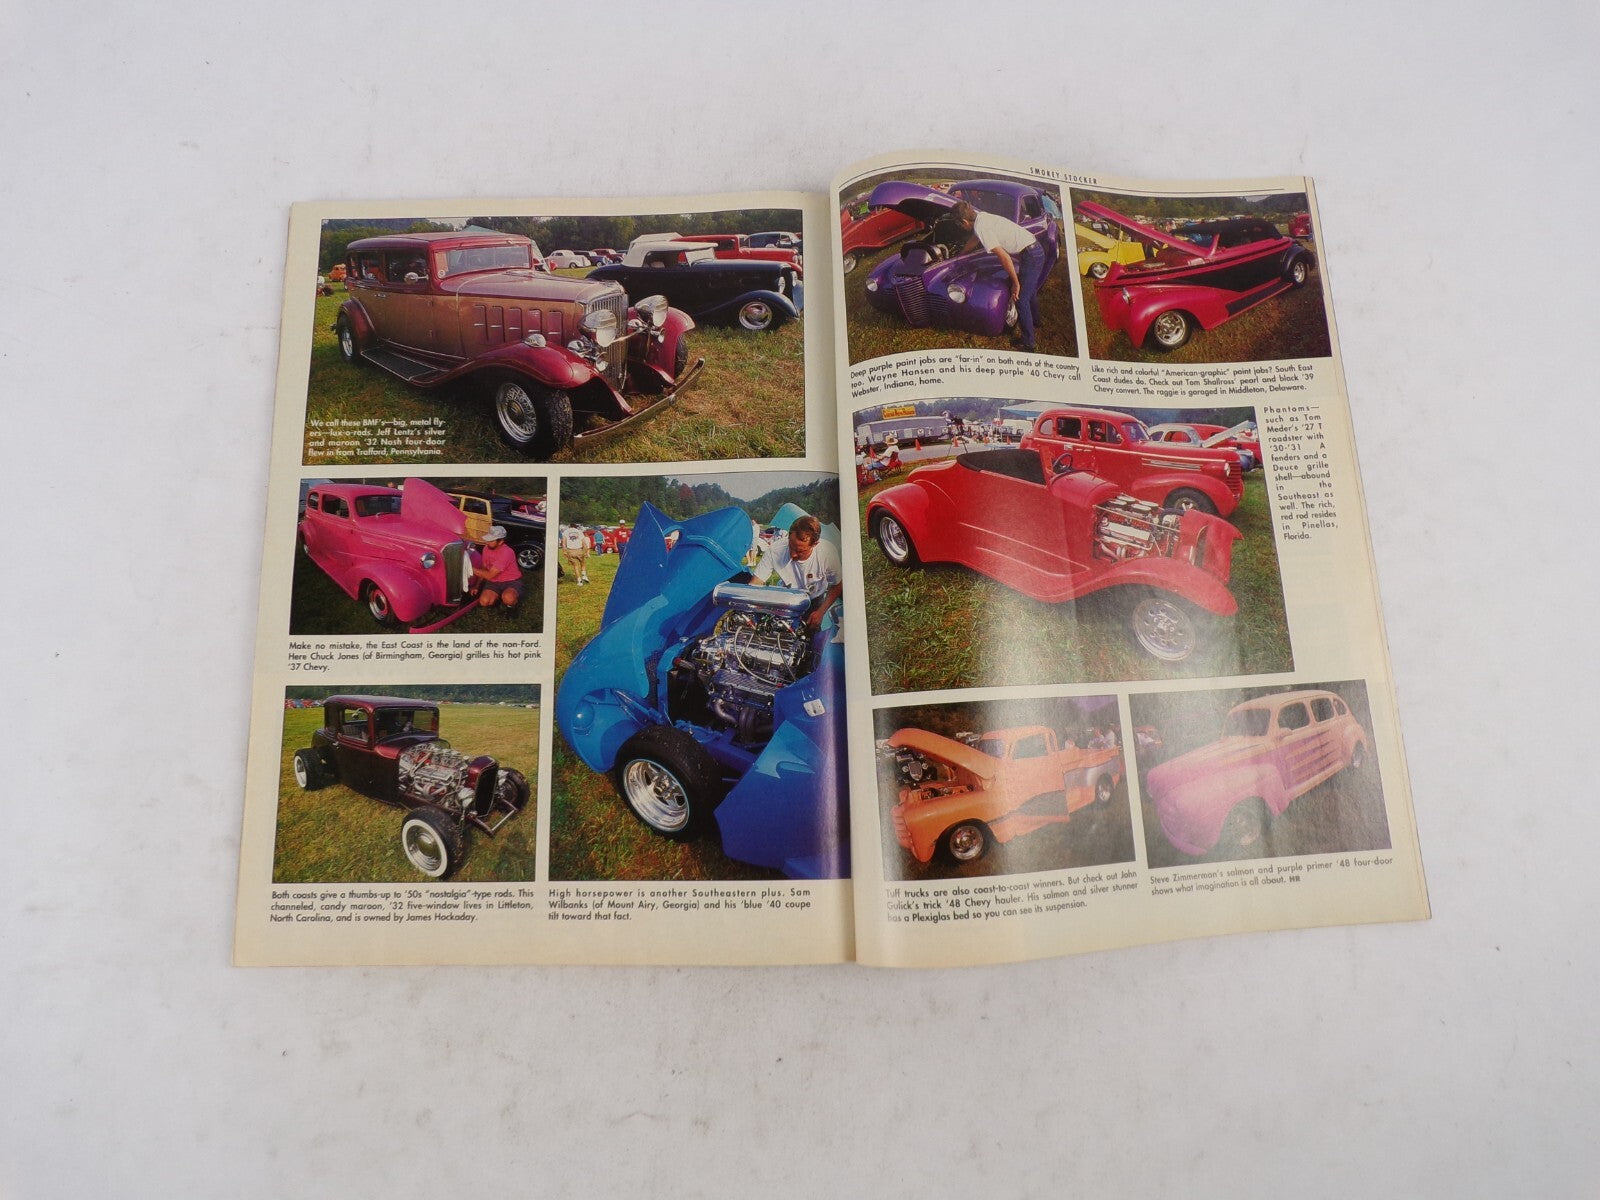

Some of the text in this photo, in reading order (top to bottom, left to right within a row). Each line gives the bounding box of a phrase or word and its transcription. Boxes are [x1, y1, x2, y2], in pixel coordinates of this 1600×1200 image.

[1030, 167, 1097, 184] SMOKEY STOCKER
[851, 370, 866, 379] Deep
[869, 362, 893, 374] purple
[896, 359, 916, 369] paint
[920, 356, 936, 366] jobs
[1017, 358, 1032, 366] ends
[1056, 364, 1079, 372] country
[1233, 368, 1251, 376] paint
[1254, 366, 1272, 375] jobs?
[852, 386, 881, 398] Webster,
[884, 379, 917, 390] Indiana,
[1266, 415, 1284, 423] such
[1267, 424, 1298, 433] Meder's
[1268, 432, 1324, 442] roadster with
[336, 448, 354, 456] from
[1271, 453, 1300, 461] fenders
[1304, 451, 1318, 459] and
[1307, 461, 1328, 471] grille
[1319, 480, 1332, 488] the
[1278, 492, 1319, 500] Southeast
[1280, 502, 1298, 510] well.
[1319, 500, 1335, 508] rich,
[1281, 512, 1293, 520] red
[1312, 510, 1336, 518] resides
[1302, 520, 1338, 529] Pinellas,
[1284, 532, 1312, 540] Florida.
[289, 642, 311, 650] Make
[329, 642, 362, 650] mistake,
[366, 641, 377, 649] the
[437, 640, 449, 648] the
[453, 640, 470, 648] land
[474, 640, 482, 648] of
[487, 640, 498, 648] the
[502, 640, 541, 648] non-Ford.
[310, 652, 334, 660] Chuck
[337, 652, 359, 660] Jones
[363, 652, 372, 660] (of
[376, 652, 424, 661] Birmingham,
[428, 651, 463, 660] Georgia)
[466, 651, 489, 660] grilles
[508, 650, 521, 658] hot
[524, 650, 541, 660] pink
[303, 663, 330, 672] Chevy.
[1151, 876, 1169, 884] Steve
[1227, 868, 1254, 876] salmon
[1258, 864, 1273, 873] and
[1278, 863, 1302, 874] purple
[1307, 862, 1332, 872] primer
[905, 888, 929, 898] trucks
[952, 886, 969, 896] also
[974, 882, 1029, 894] coast-to-coast
[1033, 880, 1064, 888] winners.
[1068, 877, 1080, 885] But
[1083, 874, 1103, 883] check
[1121, 870, 1137, 880] John
[272, 891, 289, 899] Both
[293, 891, 317, 899] coasts
[320, 891, 337, 901] give
[349, 890, 390, 900] thumbs-up
[405, 890, 422, 898] '50s
[494, 889, 514, 898] rods.
[519, 889, 533, 897] This
[549, 888, 810, 900] High horsepower is another Southeastern plus. Sam
[271, 900, 533, 912] channeled, candy maroon, '32 five-window lives in Littleton,
[549, 900, 588, 909] Wilbanks
[593, 900, 604, 909] (of
[638, 901, 658, 911] Airy,
[662, 900, 700, 911] Georgia)
[704, 900, 720, 909] and
[725, 900, 736, 908] his
[767, 900, 781, 908] '40
[785, 901, 811, 910] coupe
[270, 912, 477, 923] North Carolina, and is owned by James Hockaday.
